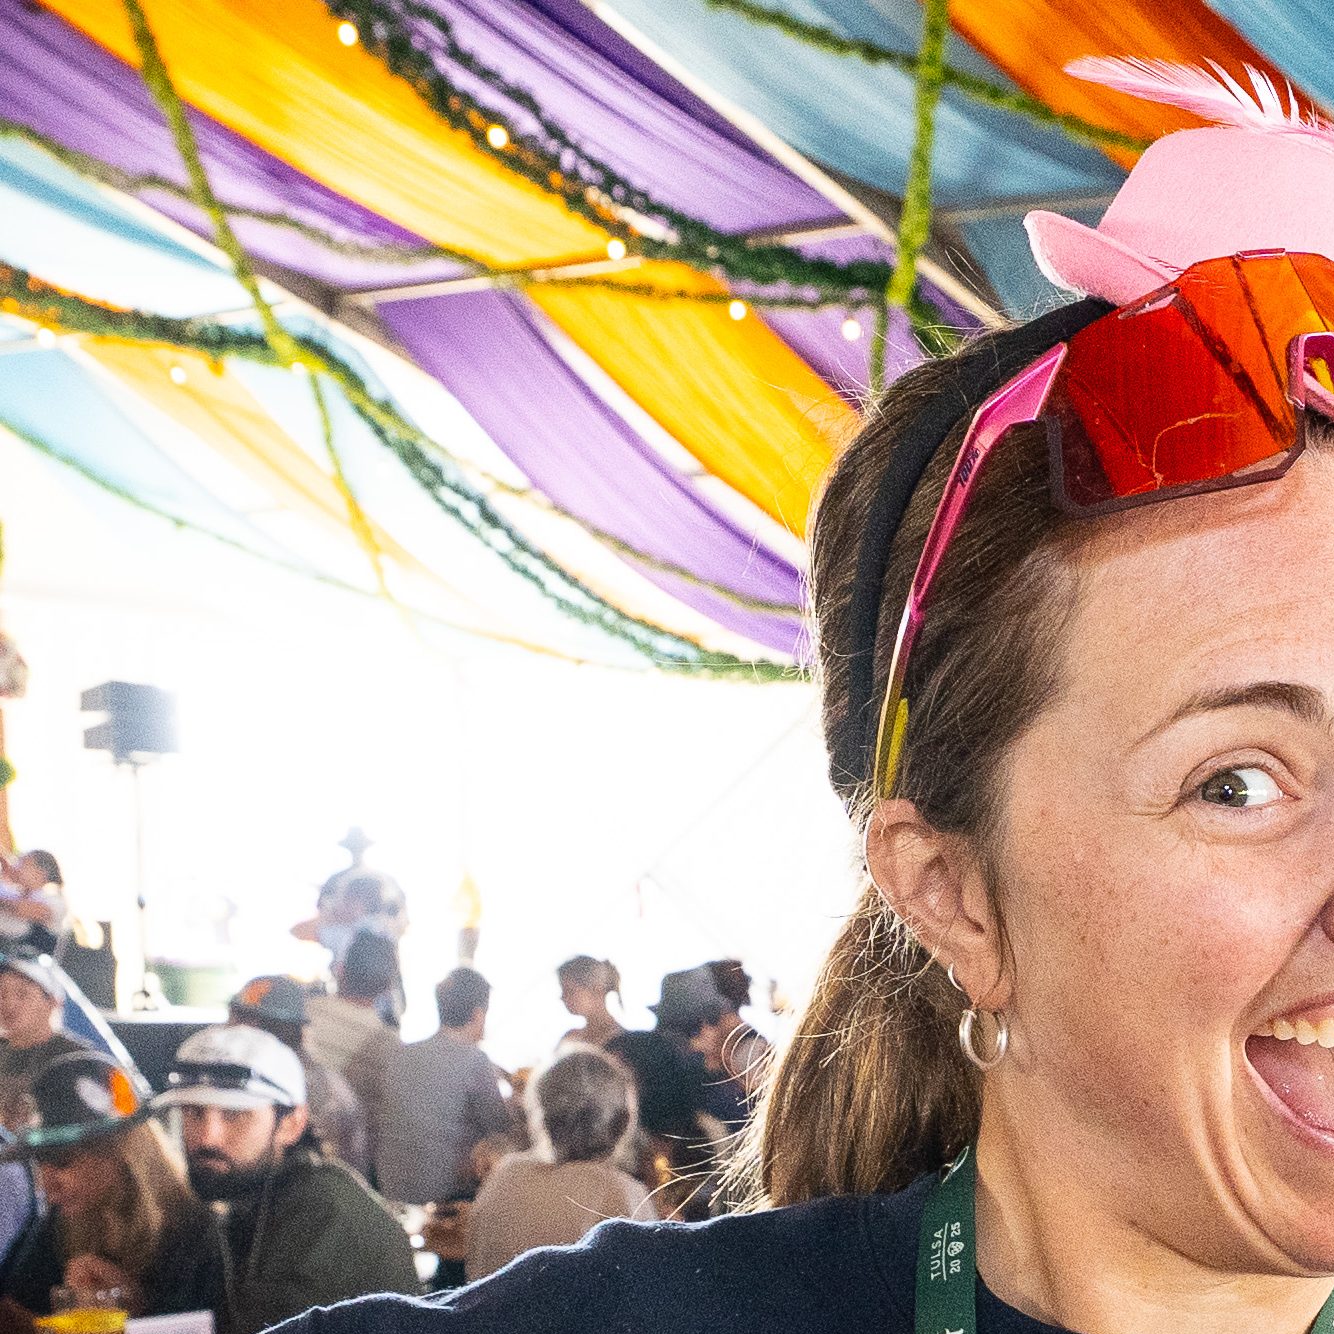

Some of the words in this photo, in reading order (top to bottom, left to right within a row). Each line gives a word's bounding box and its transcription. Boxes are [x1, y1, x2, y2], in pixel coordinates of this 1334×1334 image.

[951, 1222, 961, 1238] 25
[930, 1228, 943, 1280] TULSA
[950, 1260, 961, 1274] 20
